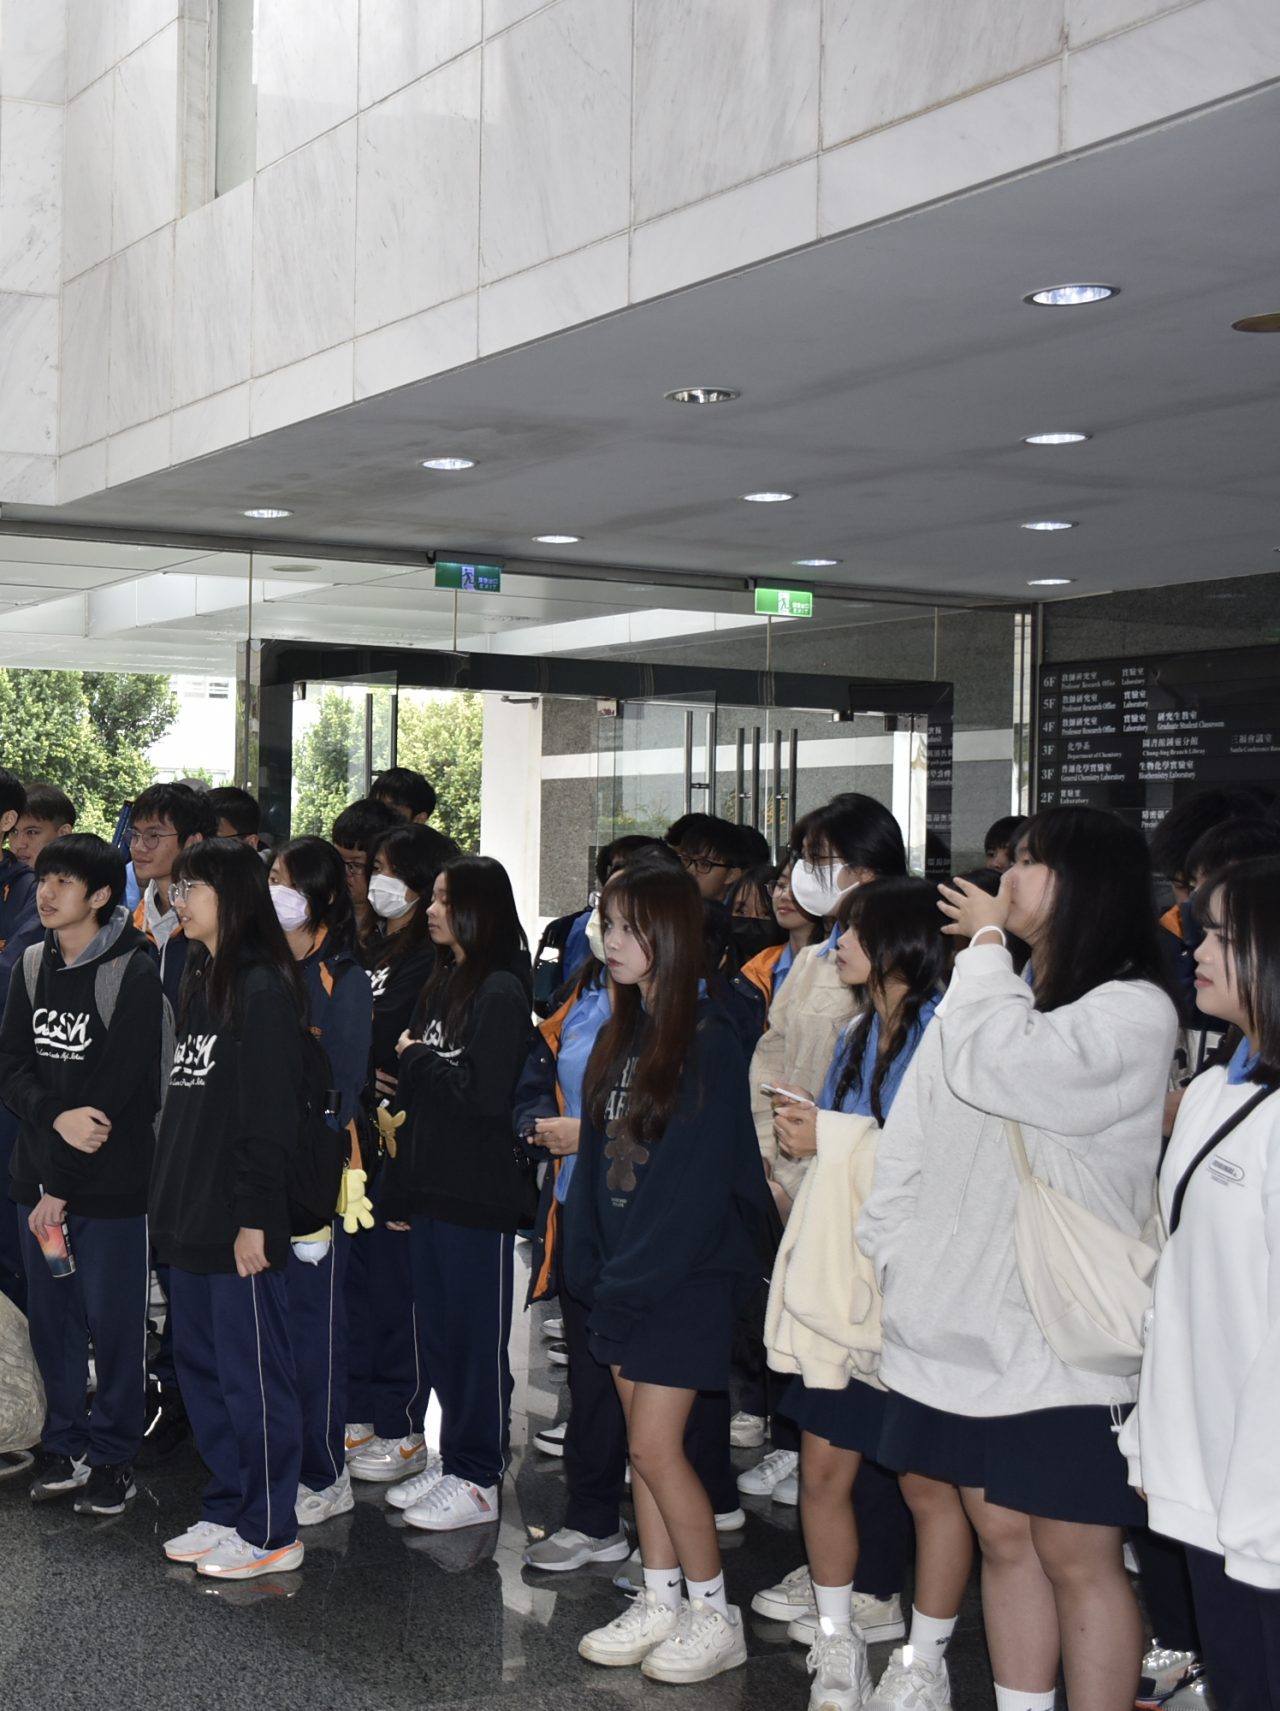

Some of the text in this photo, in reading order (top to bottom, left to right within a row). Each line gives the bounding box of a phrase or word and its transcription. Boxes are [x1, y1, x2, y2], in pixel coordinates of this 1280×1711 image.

[1043, 676, 1056, 687] 6F
[1043, 698, 1056, 709] 5F
[1043, 722, 1055, 732] 4F
[1042, 745, 1055, 756] 3F
[1041, 768, 1054, 780] 3F
[1041, 792, 1054, 803] 2F
